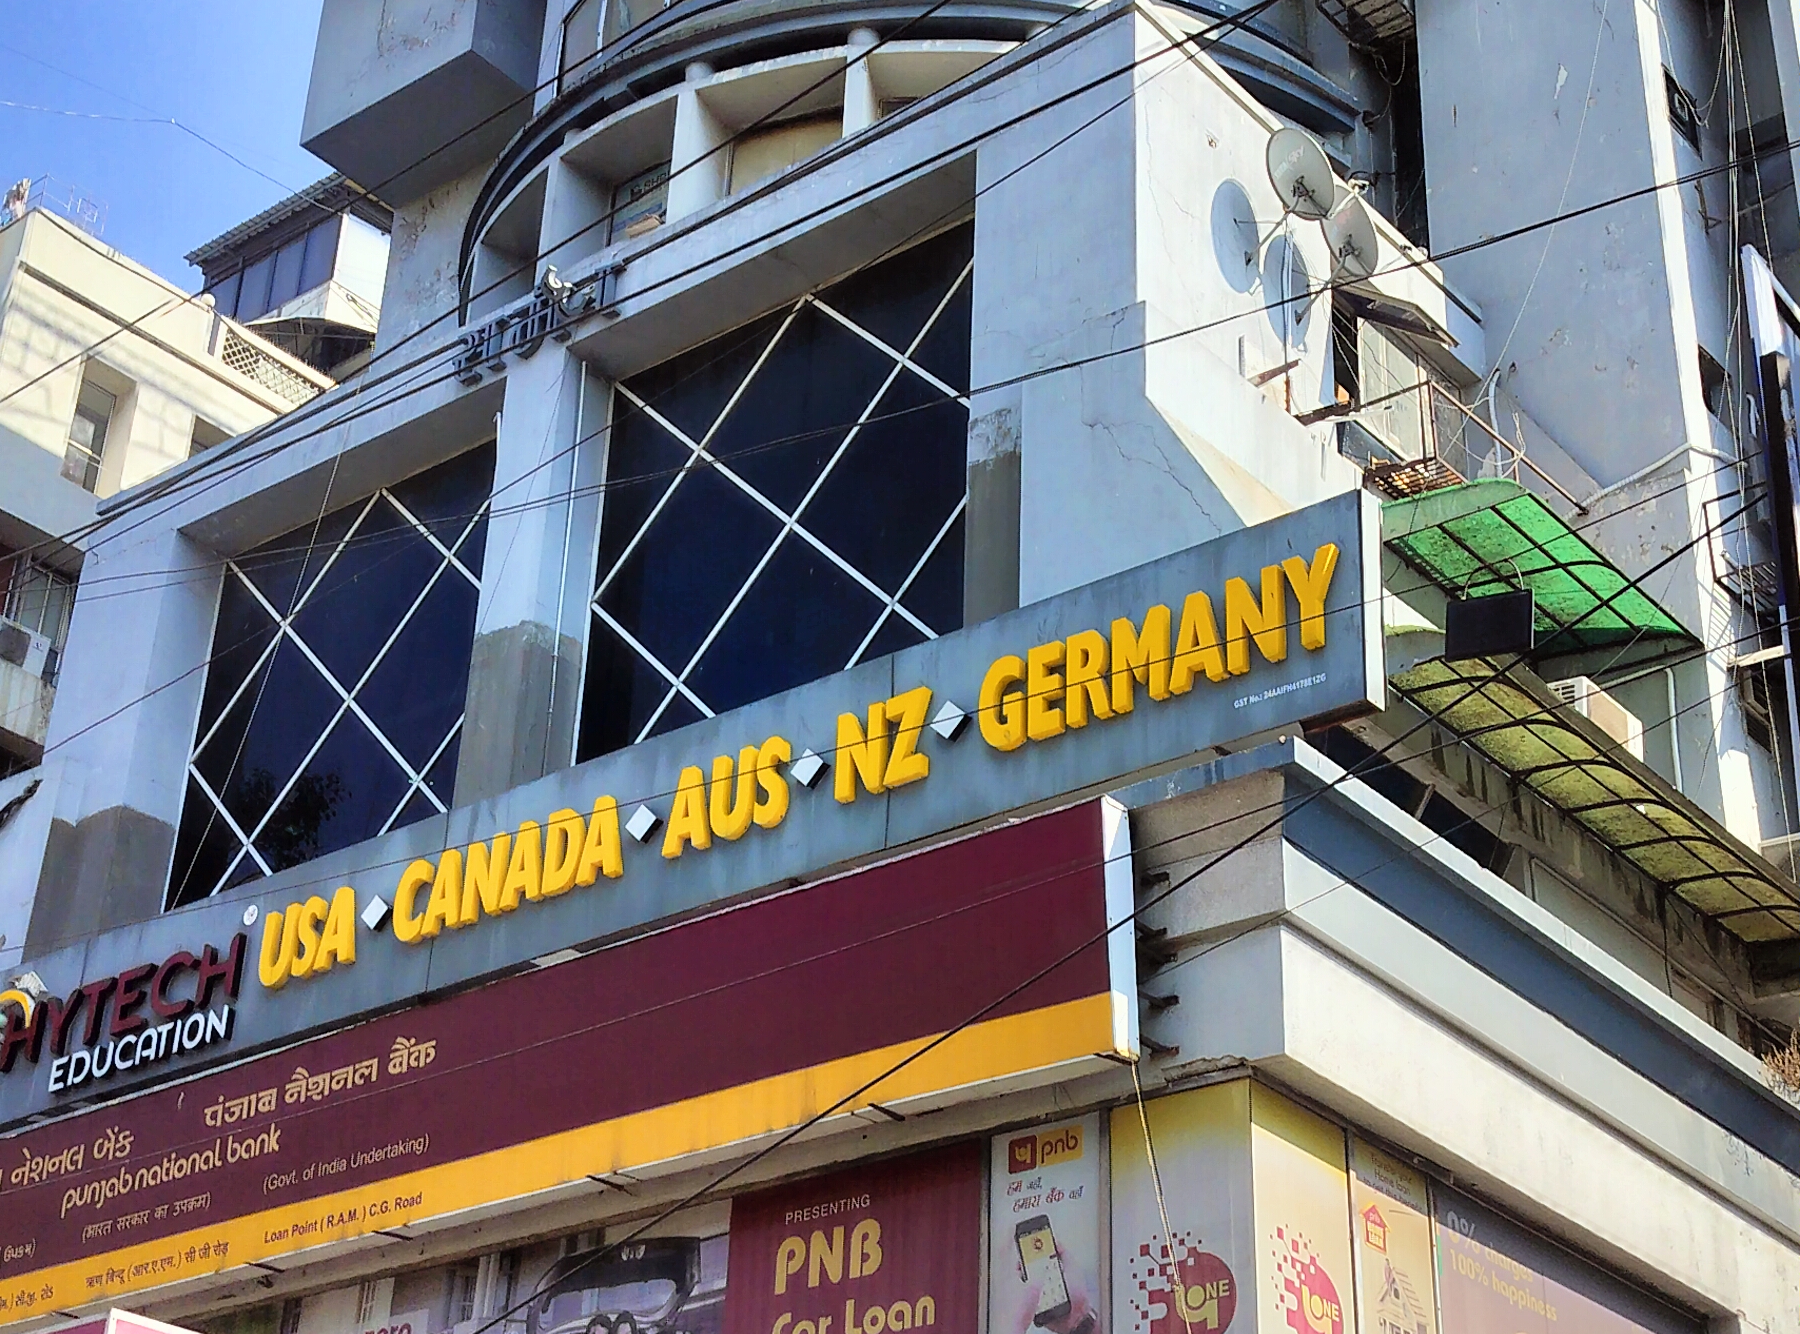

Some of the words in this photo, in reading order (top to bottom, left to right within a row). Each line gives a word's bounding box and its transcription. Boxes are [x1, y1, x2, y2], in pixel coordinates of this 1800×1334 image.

[1234, 697, 1248, 709] GST
[259, 887, 356, 989] USA
[391, 795, 623, 944] CANADA
[662, 735, 791, 861] AUS
[835, 685, 934, 805] NZ
[978, 543, 1341, 753] GERMANY
[48, 1004, 231, 1093] EDUCATION
[285, 1057, 379, 1104] नैशनल
[388, 1036, 437, 1075] बैंक
[133, 1138, 222, 1189] national
[227, 1123, 281, 1165] bank
[263, 1169, 298, 1195] (Govt.
[302, 1164, 316, 1182] of
[317, 1158, 347, 1177] India
[350, 1133, 430, 1169] Undertaking)
[1041, 1129, 1079, 1164] pnb
[264, 1224, 289, 1244] Loan
[291, 1219, 318, 1236] Point
[369, 1199, 391, 1217] C.G.
[394, 1192, 423, 1210] Road
[785, 1194, 871, 1225] PRESENTING
[774, 1218, 883, 1295] PNB
[1450, 1248, 1488, 1286] 100%
[1492, 1270, 1557, 1321] happiness
